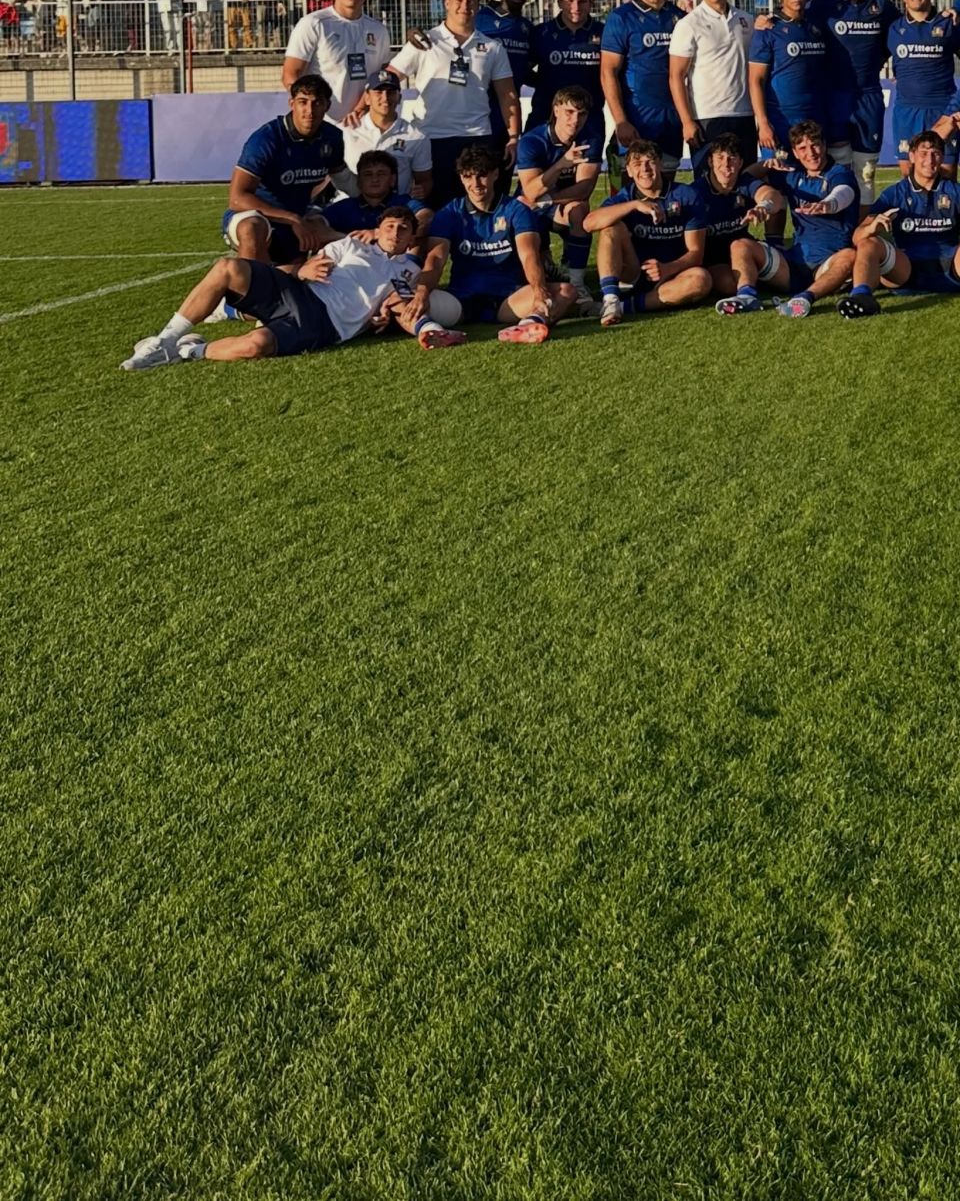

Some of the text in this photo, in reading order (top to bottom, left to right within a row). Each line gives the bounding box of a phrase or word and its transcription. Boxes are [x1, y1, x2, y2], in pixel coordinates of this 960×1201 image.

[846, 21, 880, 29] Vittoria
[907, 44, 943, 52] Vittoria
[562, 51, 600, 59] Vittoria
[914, 218, 952, 227] Vittoria
